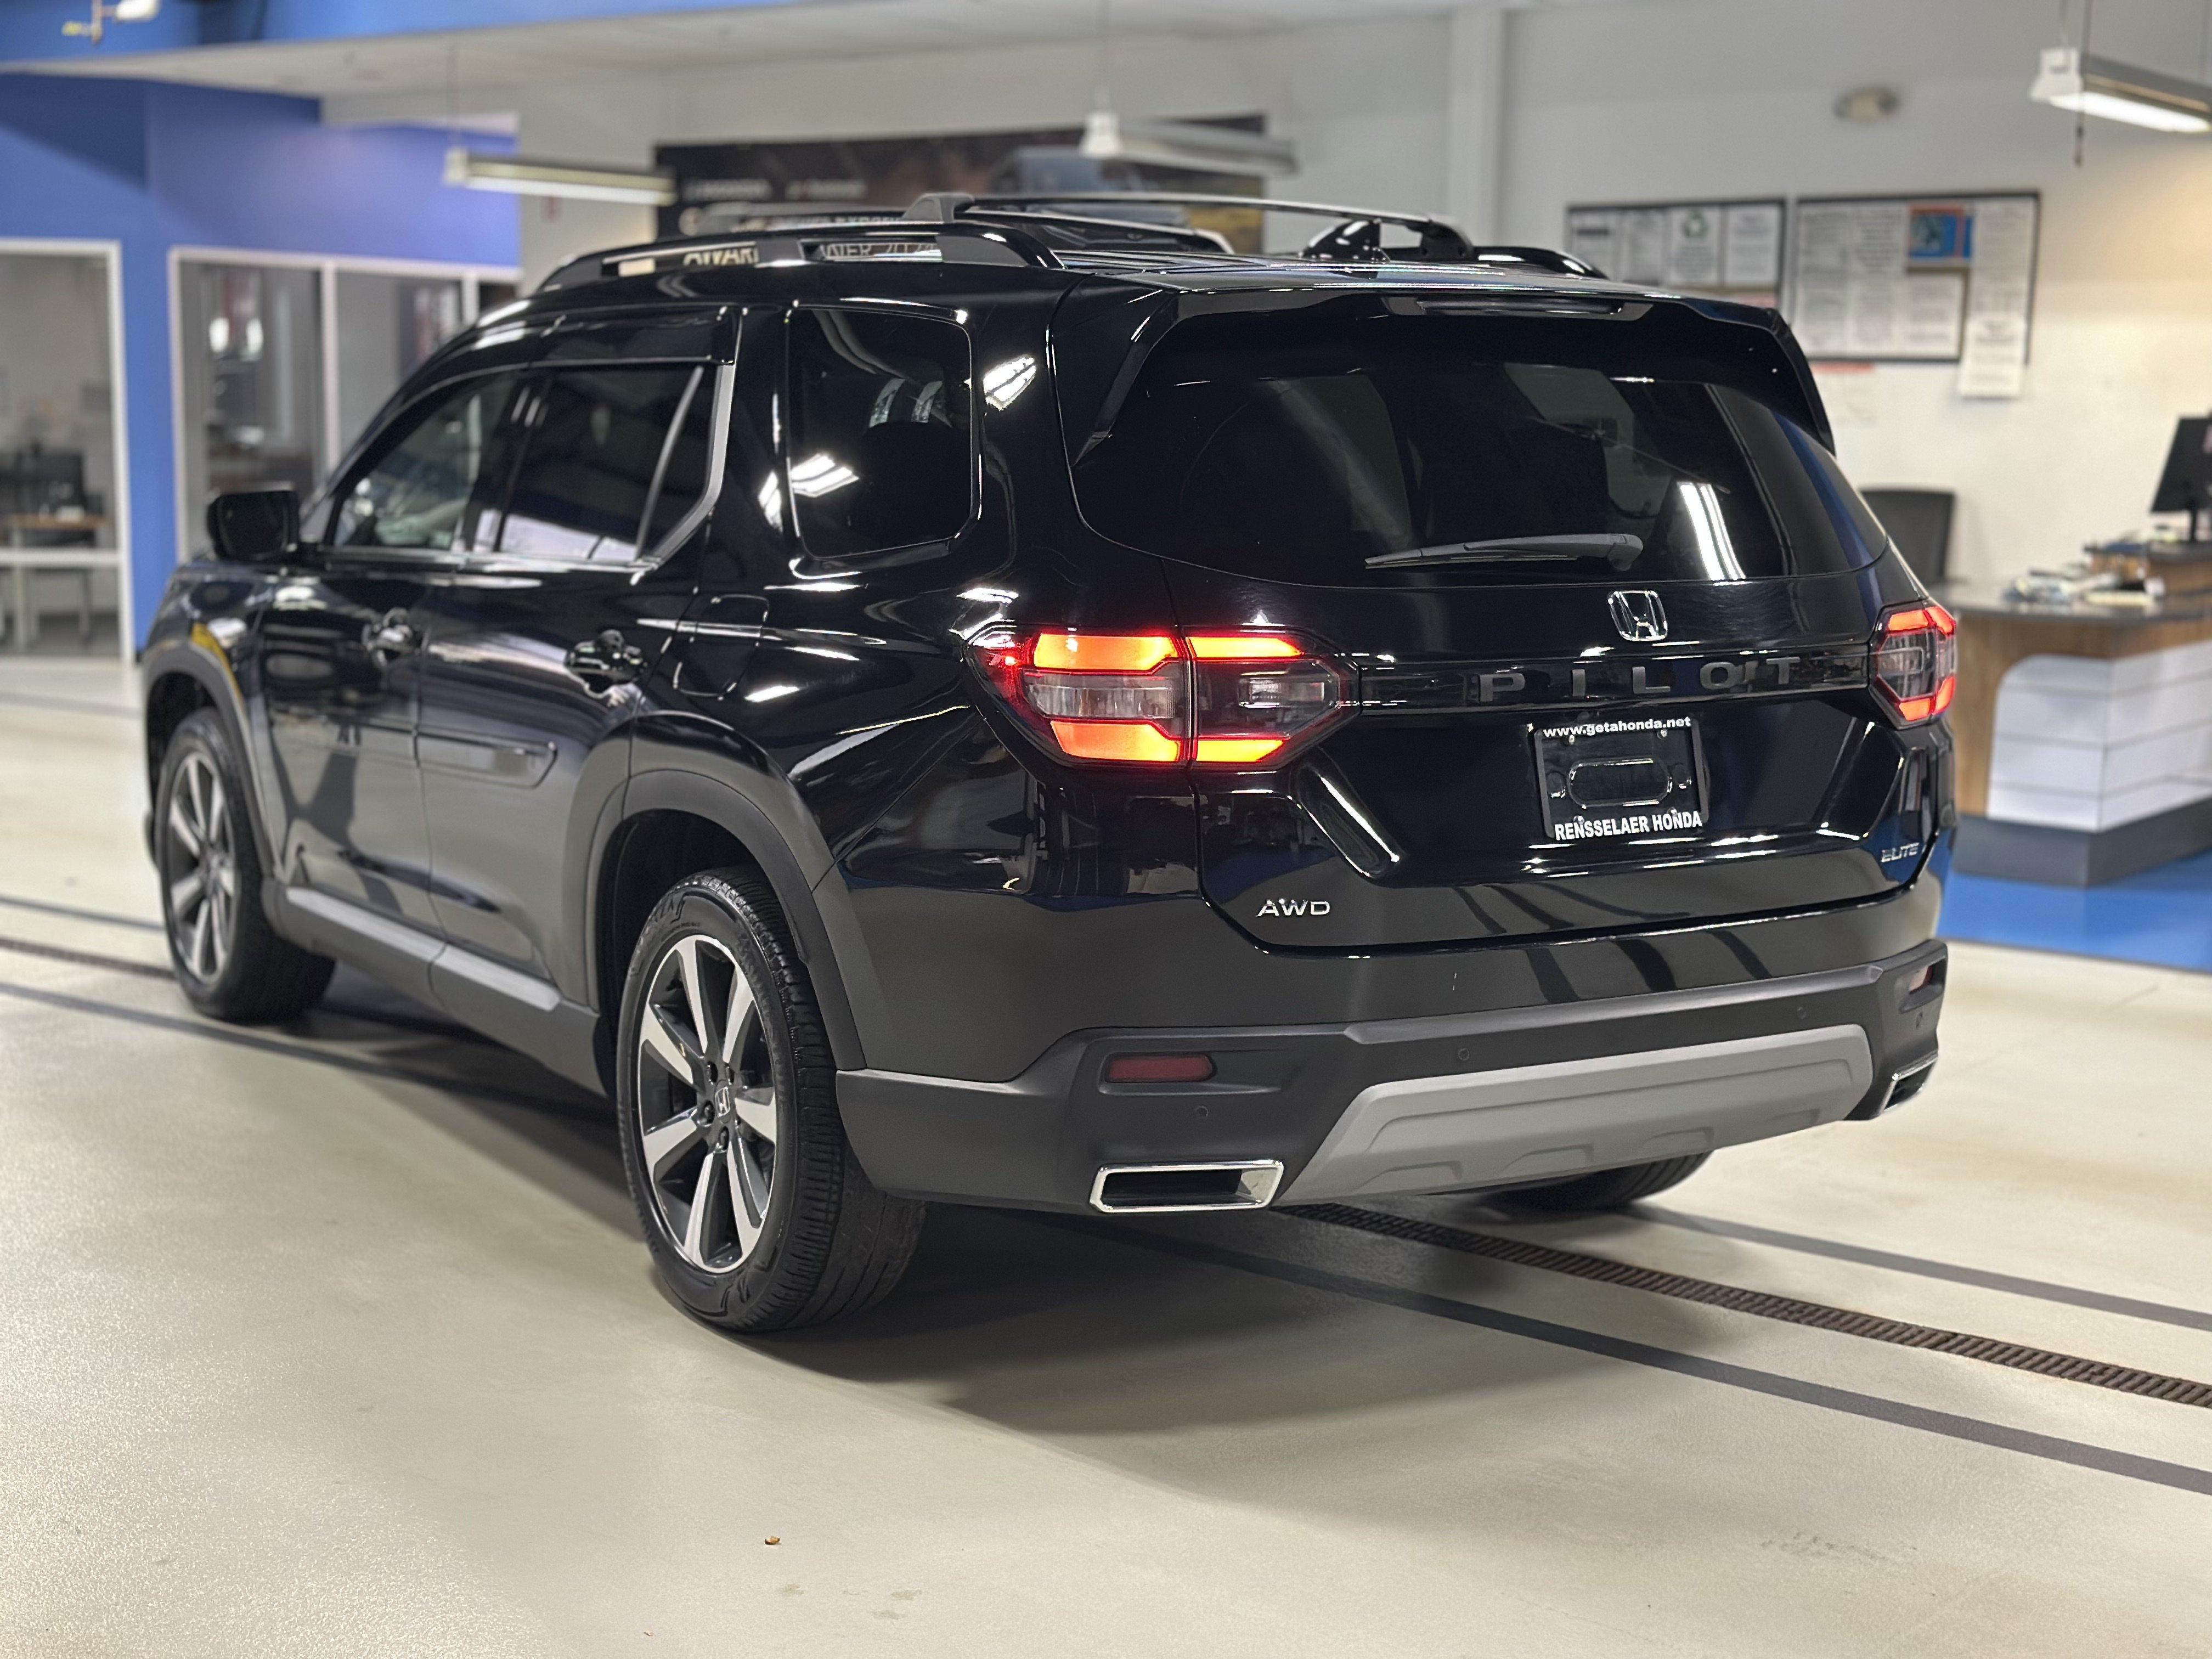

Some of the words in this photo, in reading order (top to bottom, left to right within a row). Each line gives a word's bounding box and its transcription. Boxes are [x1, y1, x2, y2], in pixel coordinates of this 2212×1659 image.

[1479, 657, 1801, 702] PILOT
[1543, 716, 1691, 736] www.getahonda.net
[1554, 816, 1650, 841] RENSSELAER
[1651, 810, 1703, 832] HONDA
[1881, 842, 1920, 863] ELITE
[1255, 898, 1331, 917] AWD
